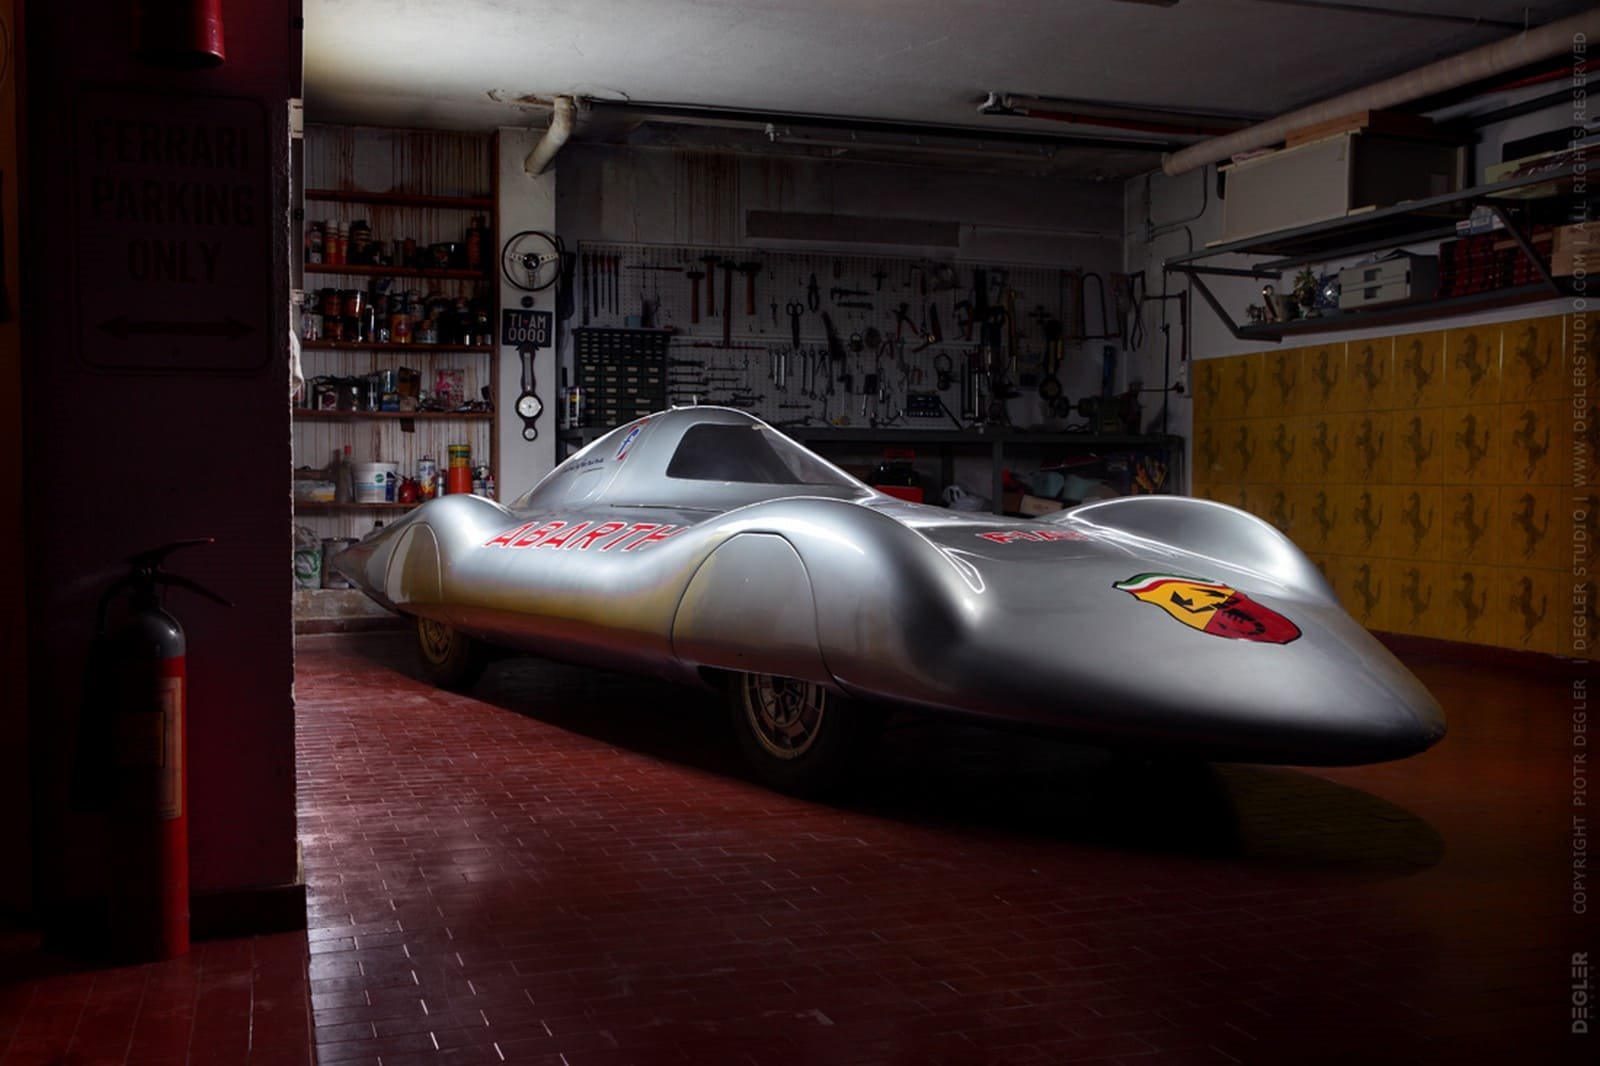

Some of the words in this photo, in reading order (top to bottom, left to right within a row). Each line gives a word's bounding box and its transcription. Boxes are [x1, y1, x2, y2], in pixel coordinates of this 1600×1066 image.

[93, 119, 250, 168] FERRARI
[92, 175, 256, 226] PARKING
[128, 238, 222, 284] ONLY
[482, 521, 690, 552] ABARTH
